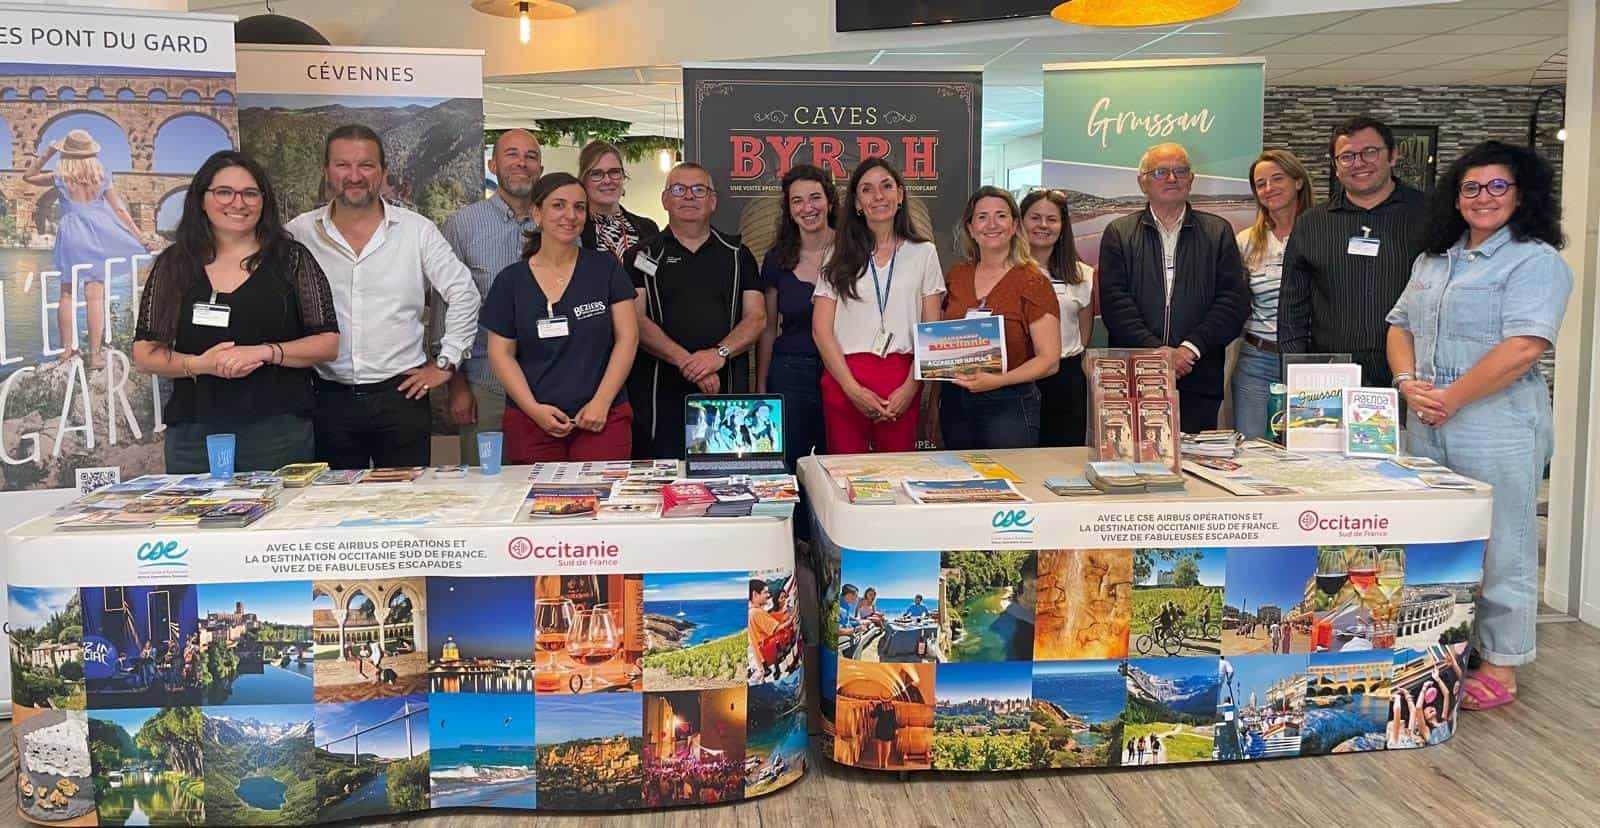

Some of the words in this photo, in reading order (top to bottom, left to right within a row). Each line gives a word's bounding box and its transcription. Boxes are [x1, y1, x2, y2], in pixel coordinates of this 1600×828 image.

[31, 28, 96, 48] PONT
[103, 31, 136, 50] DU
[144, 34, 208, 54] GARD
[306, 60, 415, 82] CÉVENNES
[794, 106, 878, 125] CAVES
[1087, 97, 1216, 148] Gruissan
[992, 509, 1035, 528] cse
[1097, 514, 1122, 522] AVEC
[1124, 514, 1135, 522] LE
[1137, 513, 1154, 522] CSE
[1157, 513, 1191, 521] AIRBUS
[1252, 512, 1263, 520] ET
[1298, 510, 1389, 531] Occitanie
[1079, 524, 1091, 532] LA
[1094, 523, 1154, 532] DESTINATION
[1157, 523, 1205, 531] OCCITANIE
[1207, 523, 1225, 531] SUD
[1227, 522, 1240, 530] DE
[1100, 533, 1128, 541] VIVEZ
[1130, 533, 1143, 541] DE
[1144, 532, 1204, 541] FABULEUSES
[1205, 532, 1258, 540] ESCAPADES
[136, 540, 189, 561] cse
[266, 543, 297, 552] AVEC
[299, 543, 312, 551] LE
[314, 542, 335, 551] CSE
[338, 541, 379, 550] AIRBUS
[453, 539, 466, 548] ET
[508, 536, 619, 560] Occitanie
[245, 554, 259, 563] LA
[262, 552, 336, 563] DESTINATION
[339, 551, 397, 561] OCCITANIE
[399, 550, 422, 559] SUD
[424, 550, 439, 559] DE
[558, 559, 574, 567] Sud
[576, 559, 587, 567] de
[589, 558, 618, 566] France
[272, 564, 305, 573] VIVEZ
[308, 564, 323, 572] DE
[325, 562, 396, 572] FABULEUSES
[399, 560, 462, 569] ESCAPADES
